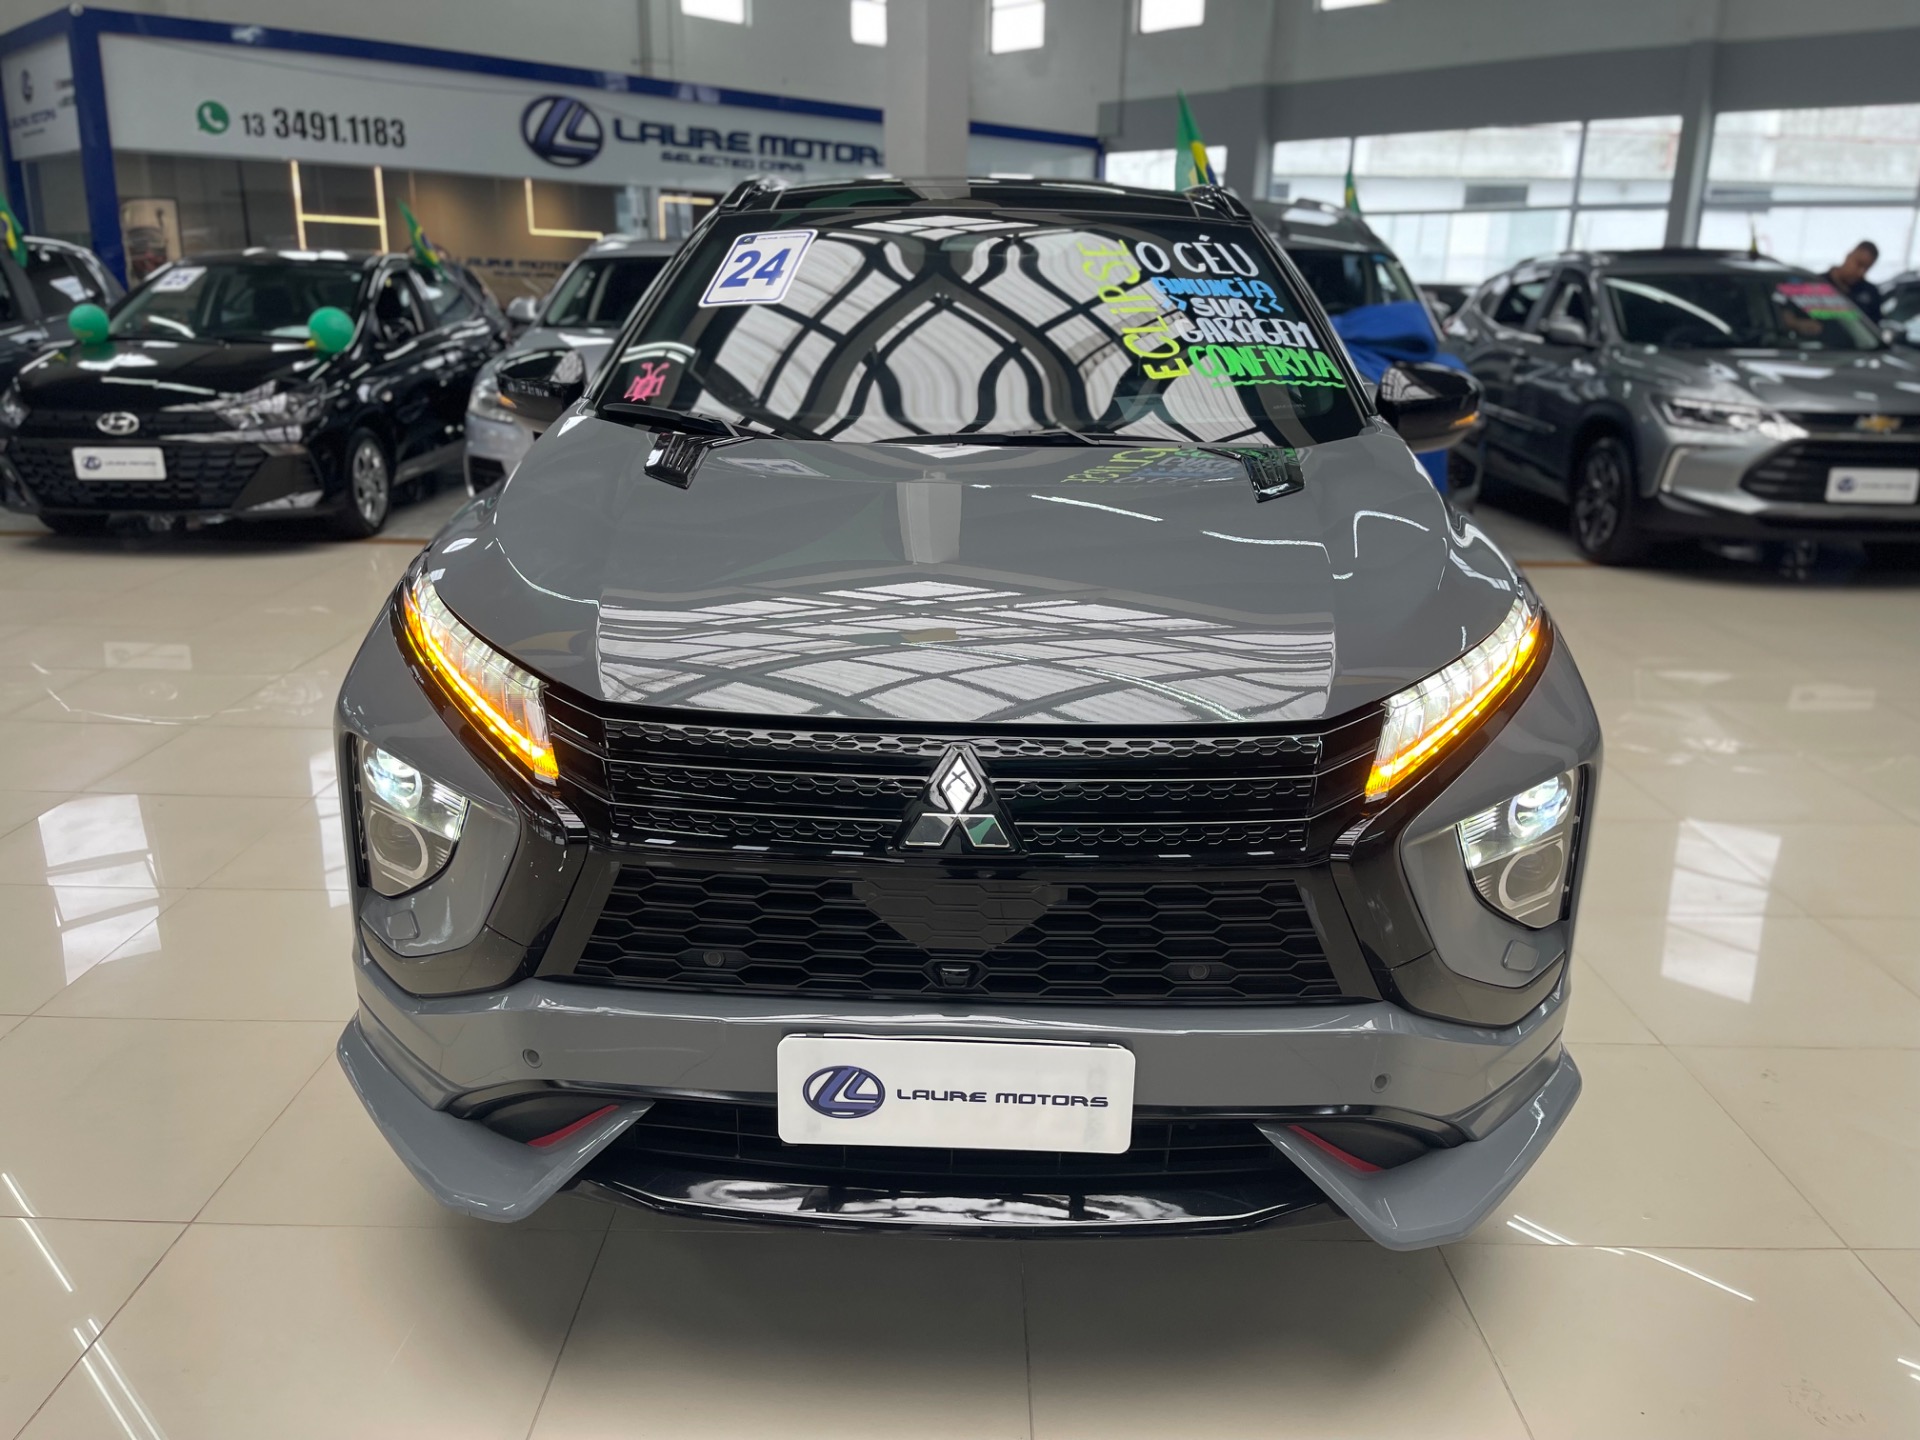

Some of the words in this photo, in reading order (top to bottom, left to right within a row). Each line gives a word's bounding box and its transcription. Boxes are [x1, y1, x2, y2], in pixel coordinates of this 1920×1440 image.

[238, 112, 265, 137] 13
[272, 108, 406, 148] 3491.1183
[613, 118, 753, 150] LAURE
[758, 133, 884, 168] MOTOR
[660, 151, 754, 171] SELECTED
[759, 158, 806, 174] CARS
[719, 248, 791, 289] 24
[1135, 241, 1171, 273] O
[1173, 234, 1259, 277] CÉU
[1189, 298, 1257, 318] SUA
[1174, 318, 1320, 349] GARAGEM
[897, 1089, 987, 1103] LAURE
[995, 1092, 1109, 1108] MOTORS
